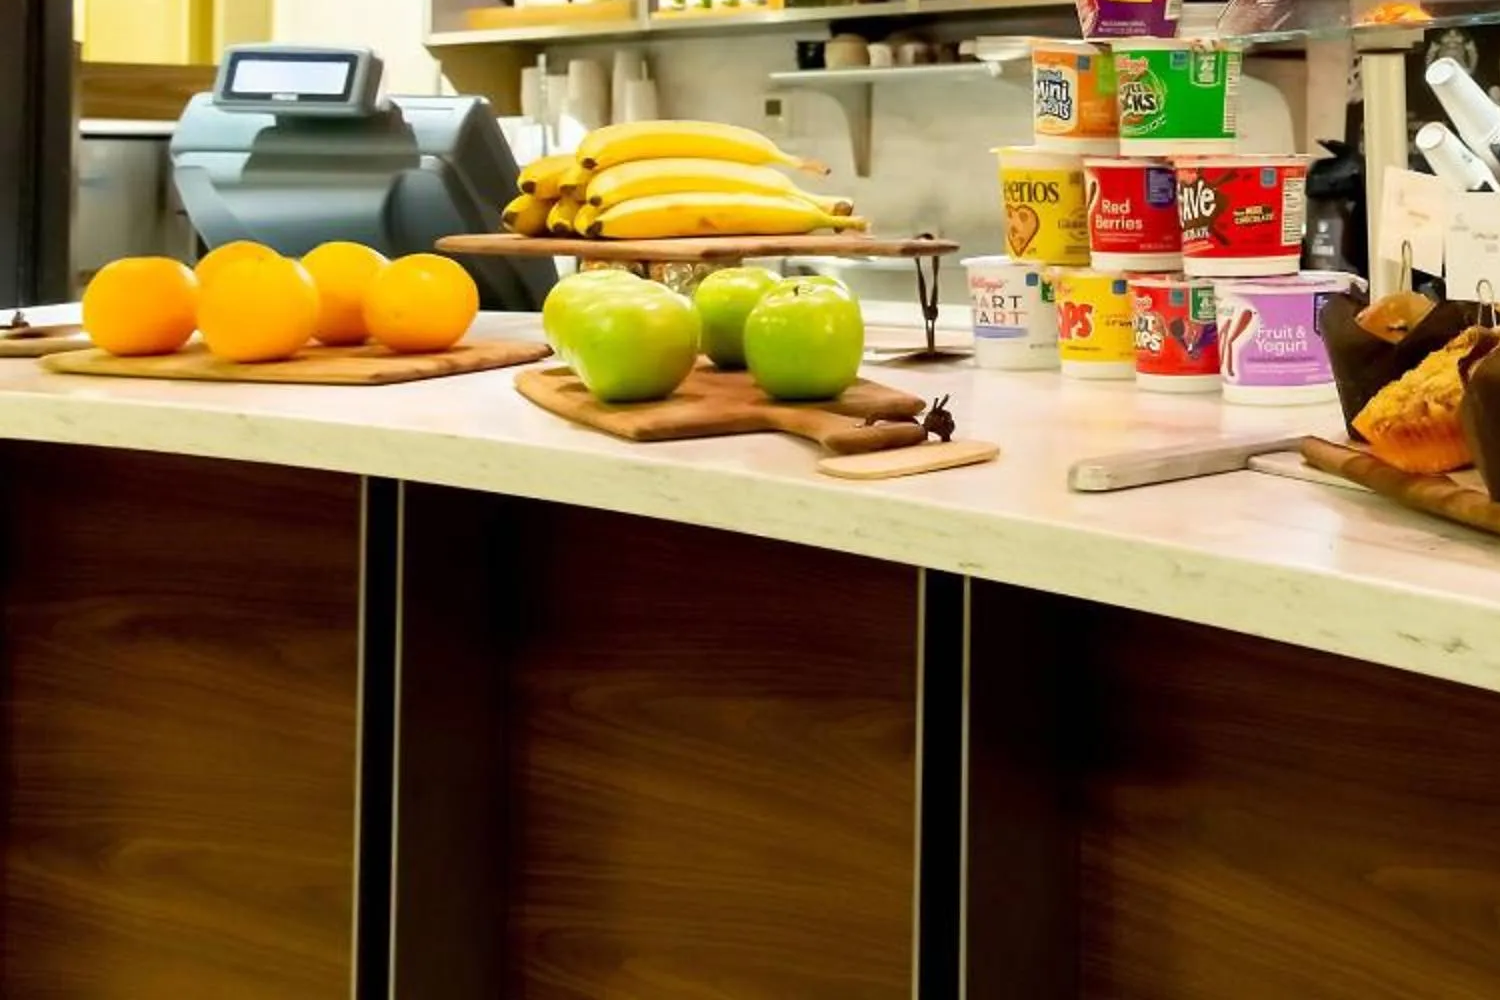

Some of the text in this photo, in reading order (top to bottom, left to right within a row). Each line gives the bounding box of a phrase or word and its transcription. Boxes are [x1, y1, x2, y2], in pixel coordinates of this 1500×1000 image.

[1101, 199, 1131, 215] Red
[1095, 215, 1144, 231] Berries
[1256, 324, 1306, 339] Fruit &
[1255, 339, 1308, 357] Yogurt
